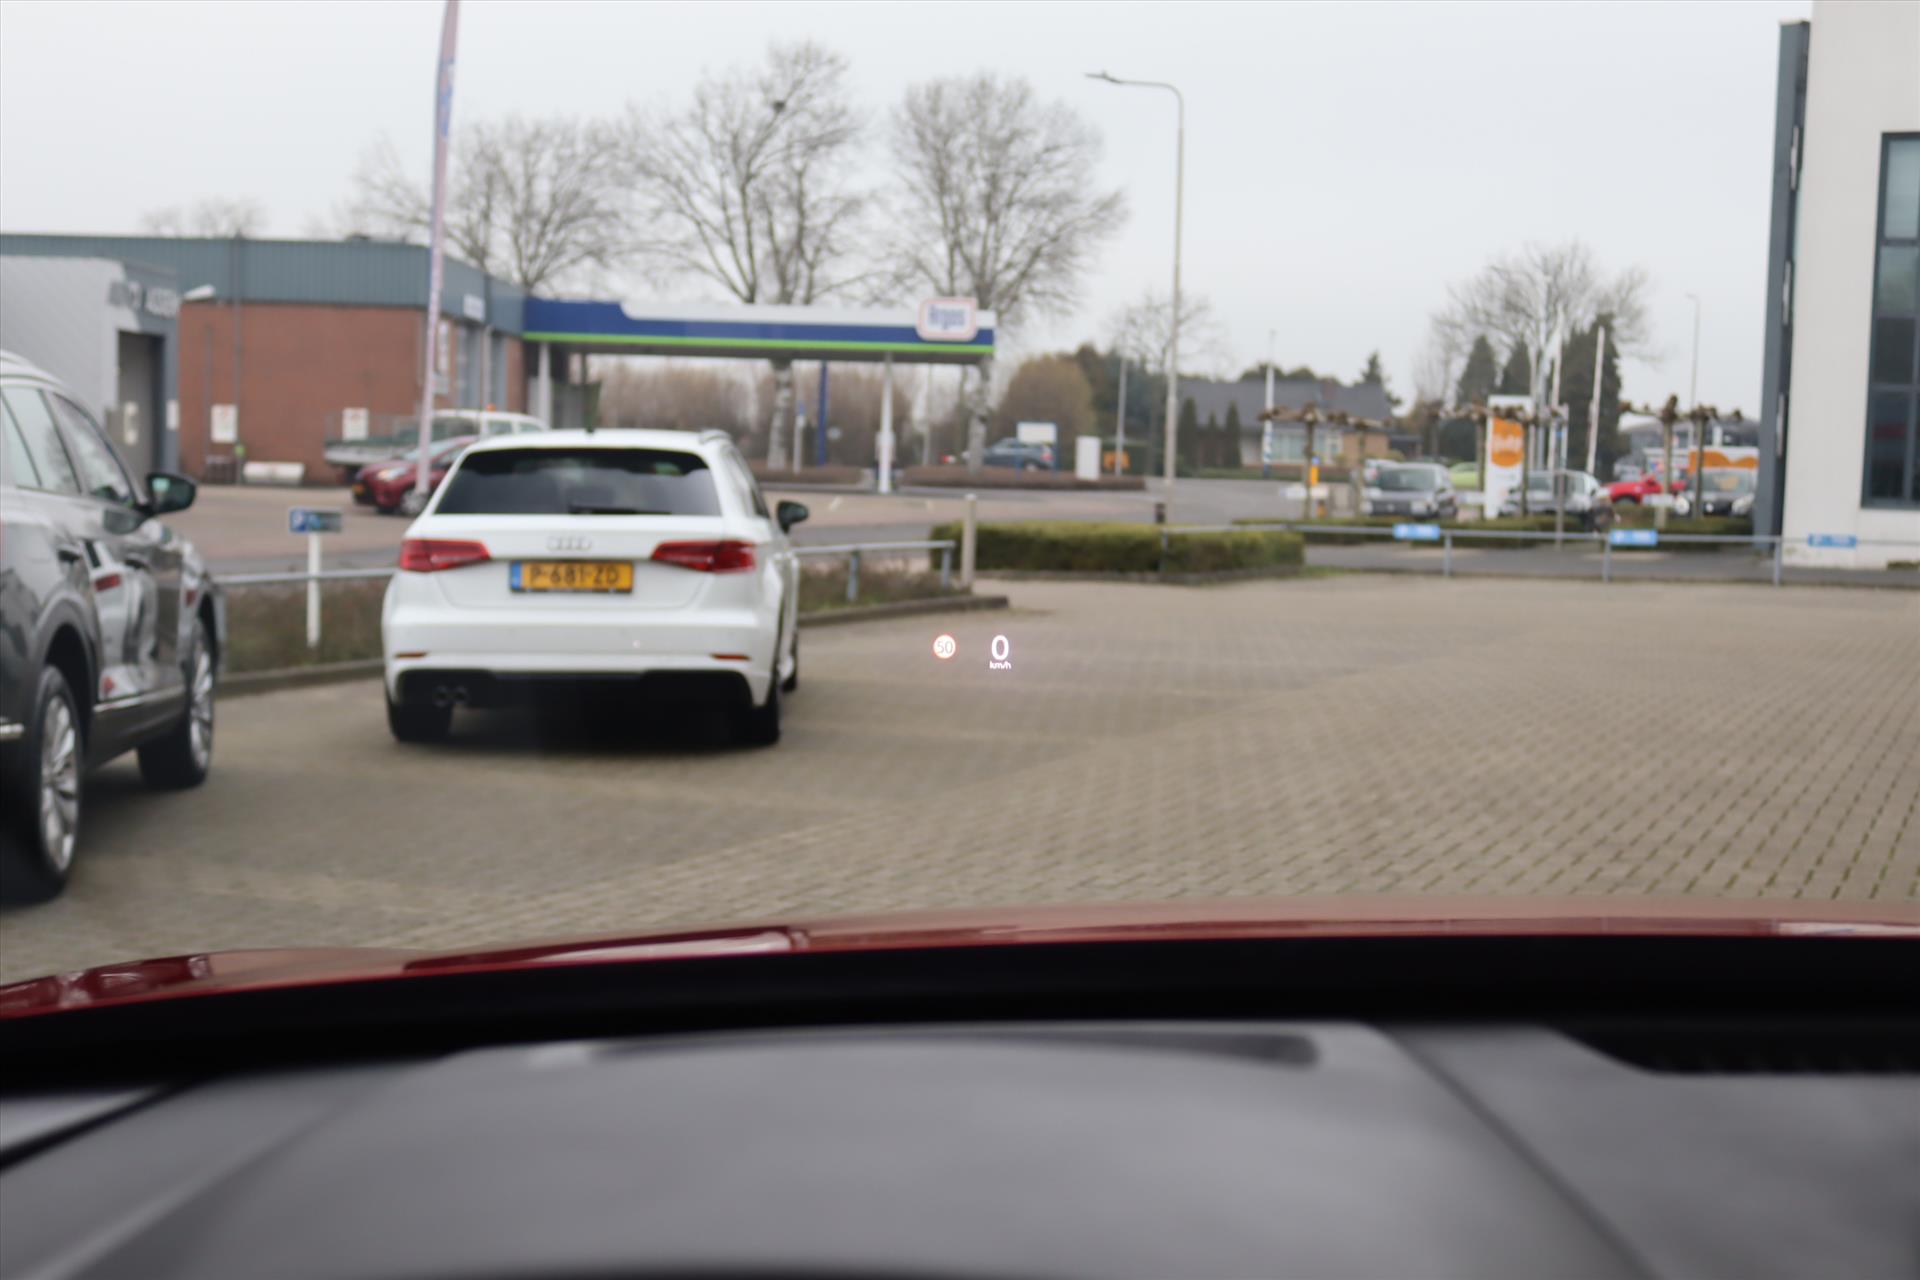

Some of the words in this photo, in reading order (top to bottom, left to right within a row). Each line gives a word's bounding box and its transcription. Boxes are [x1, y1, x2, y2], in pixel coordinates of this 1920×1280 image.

[937, 640, 954, 654] 50
[991, 634, 1009, 661] 0
[989, 660, 1012, 670] km/h
